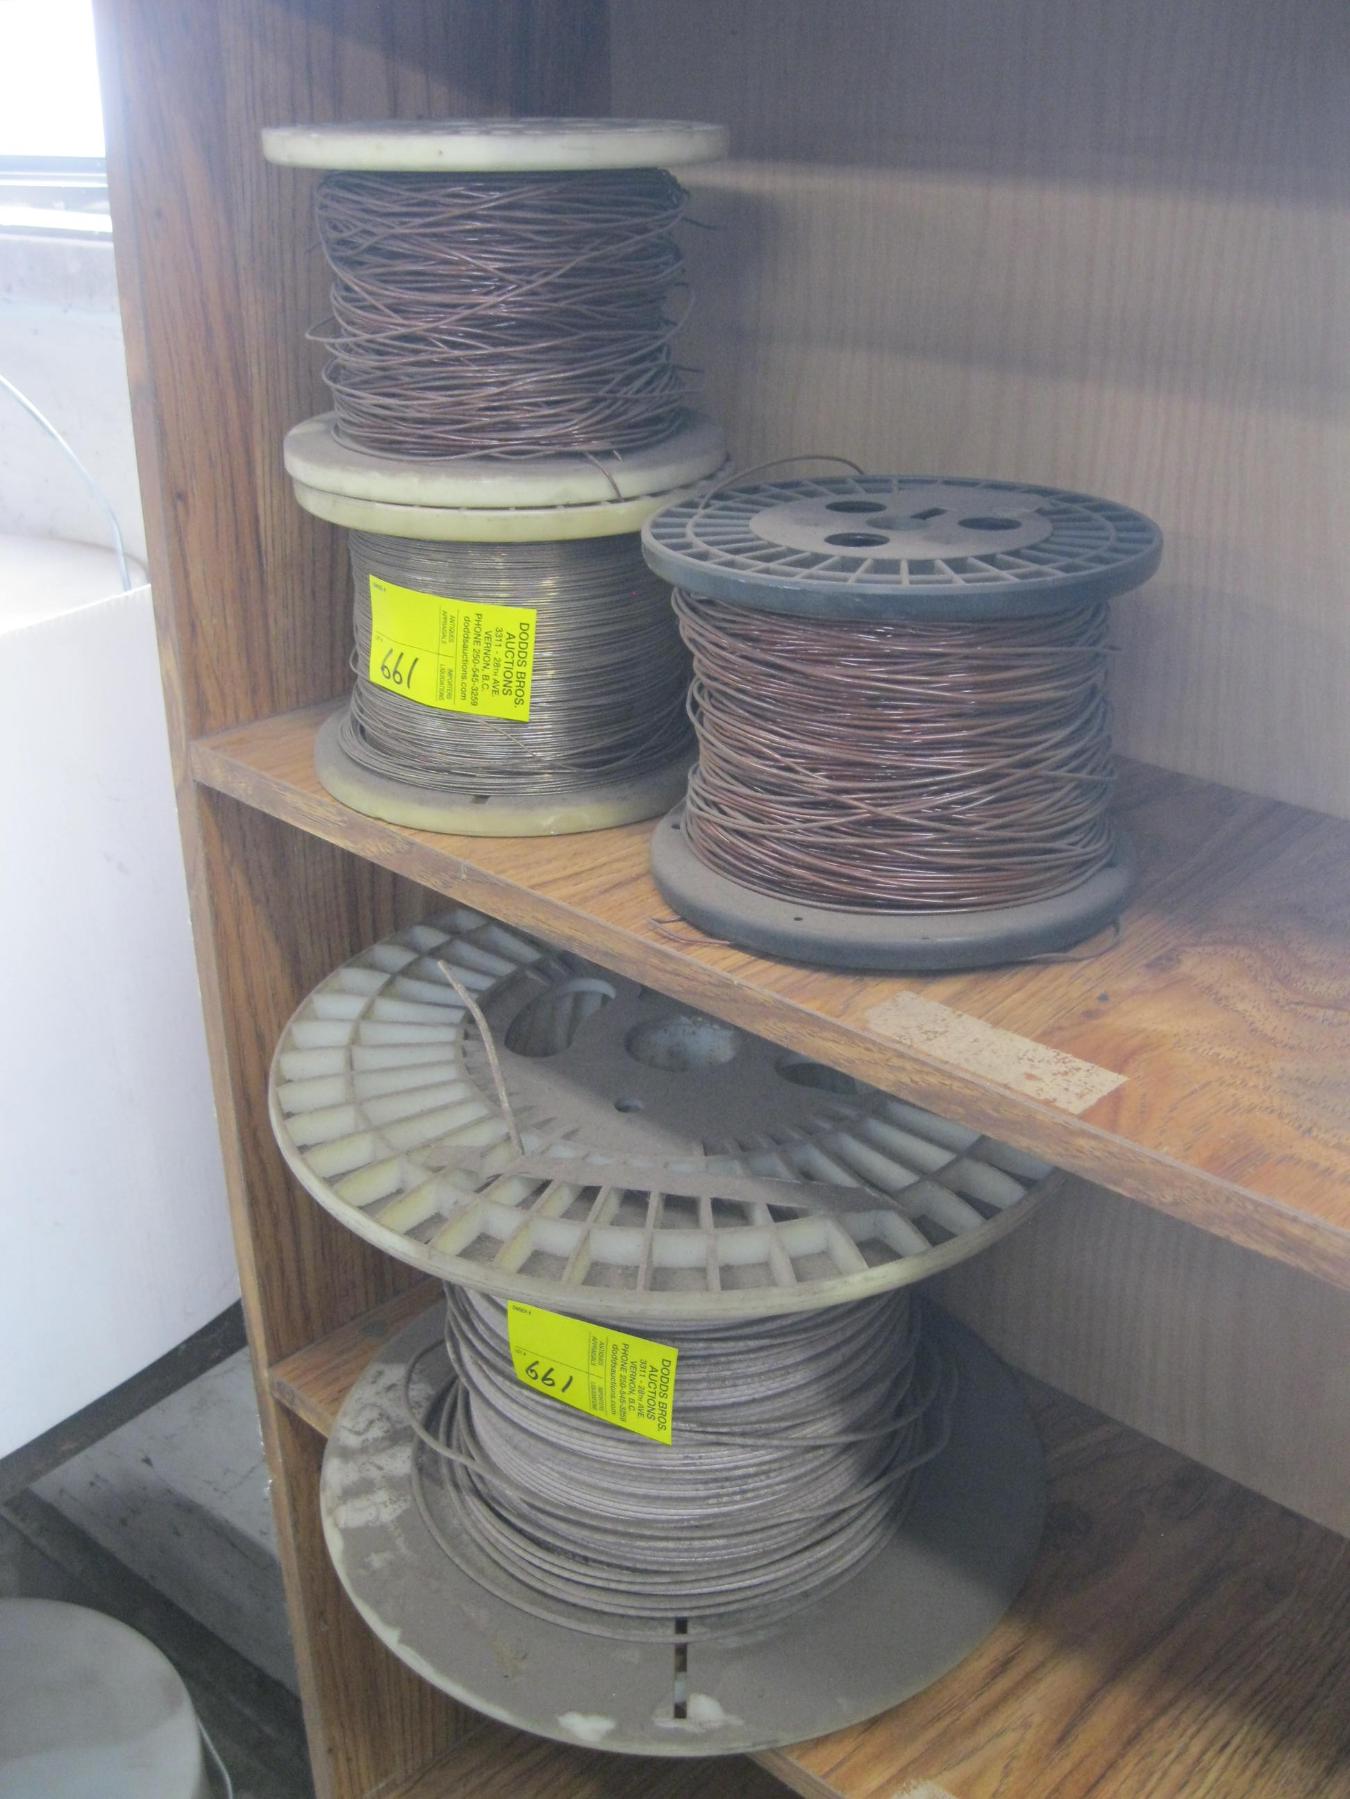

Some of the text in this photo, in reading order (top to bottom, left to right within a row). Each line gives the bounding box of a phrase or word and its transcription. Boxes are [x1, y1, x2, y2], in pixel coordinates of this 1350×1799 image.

[461, 616, 470, 700] doddsauctions.com
[471, 614, 483, 706] PHONE 250-545-3259
[481, 631, 492, 691] VERNON, B.C.
[495, 627, 503, 647] 3311
[502, 632, 515, 696] AUCTIONS
[514, 623, 529, 708] DODDS BROS.
[381, 648, 418, 689] 661
[525, 1361, 573, 1393] 661
[621, 1344, 629, 1375] PHONE
[647, 1365, 658, 1421] AUCTIONS
[657, 1359, 671, 1432] DODDS BROS.
